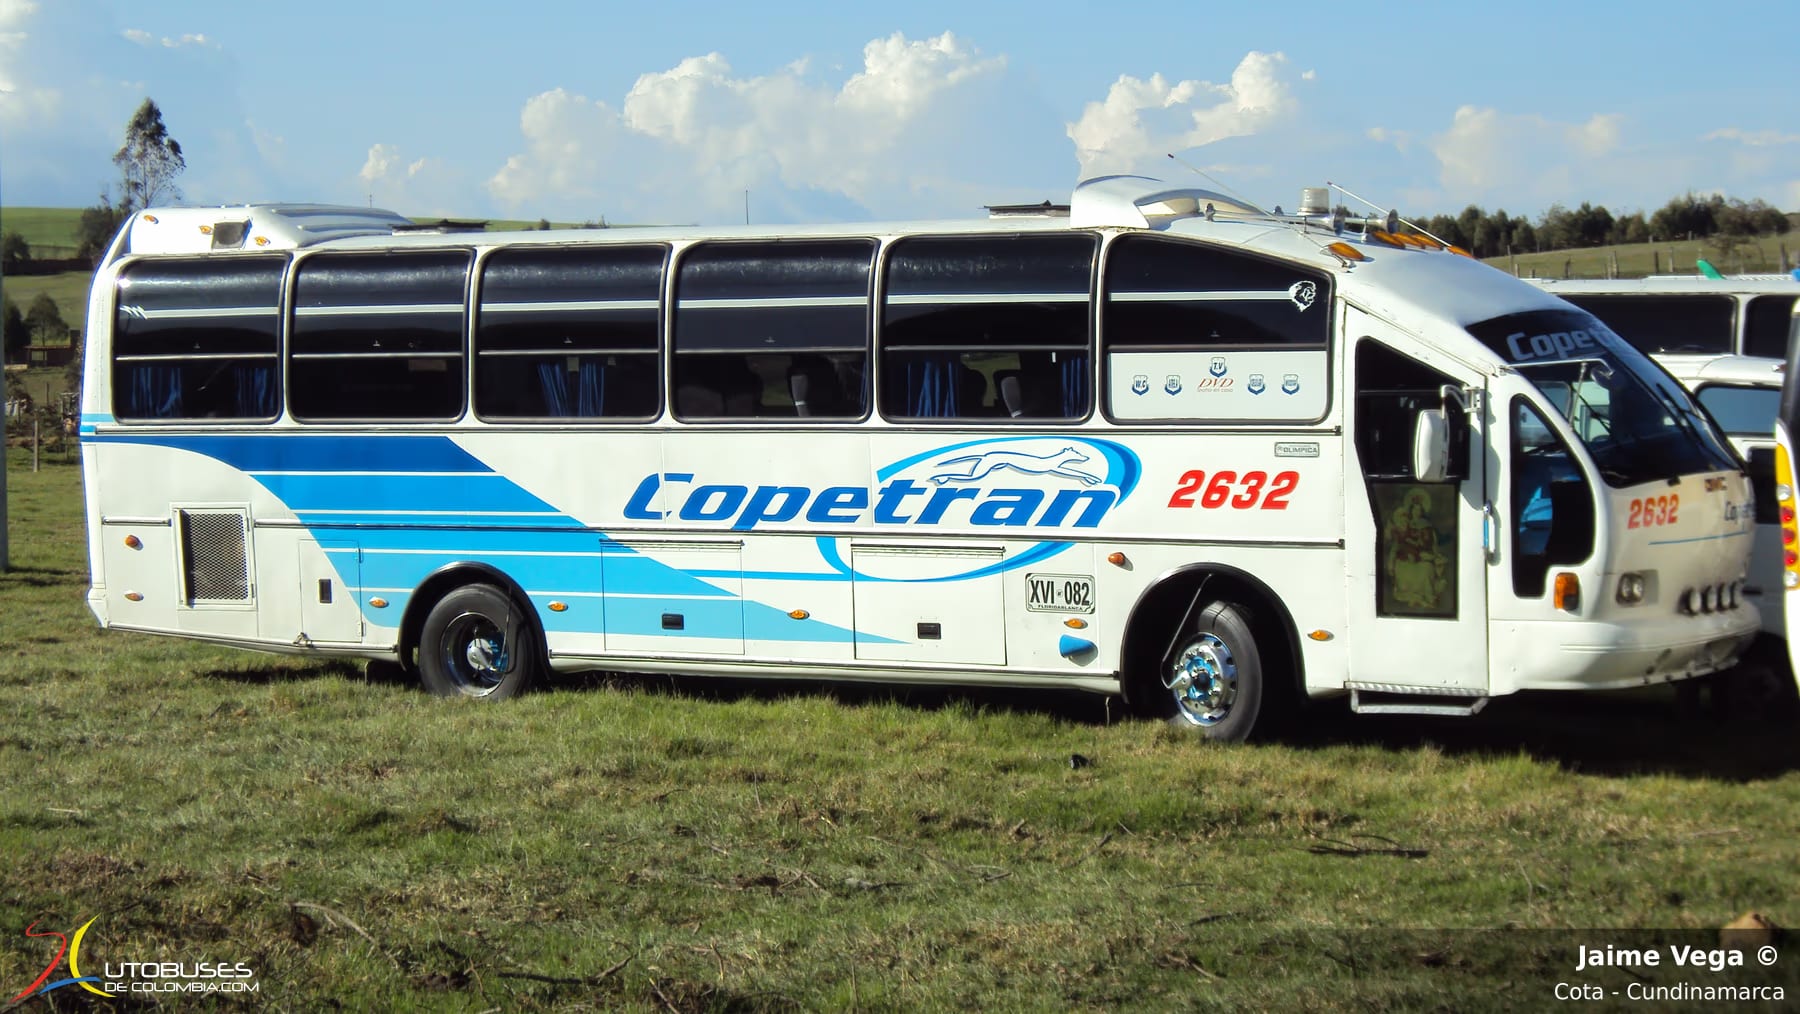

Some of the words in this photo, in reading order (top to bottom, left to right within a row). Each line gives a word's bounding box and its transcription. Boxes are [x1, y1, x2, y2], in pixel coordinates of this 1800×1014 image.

[1199, 378, 1234, 387] DVD
[623, 472, 1117, 531] Copetran
[1167, 469, 1300, 510] 2632
[1627, 494, 1680, 529] 2632
